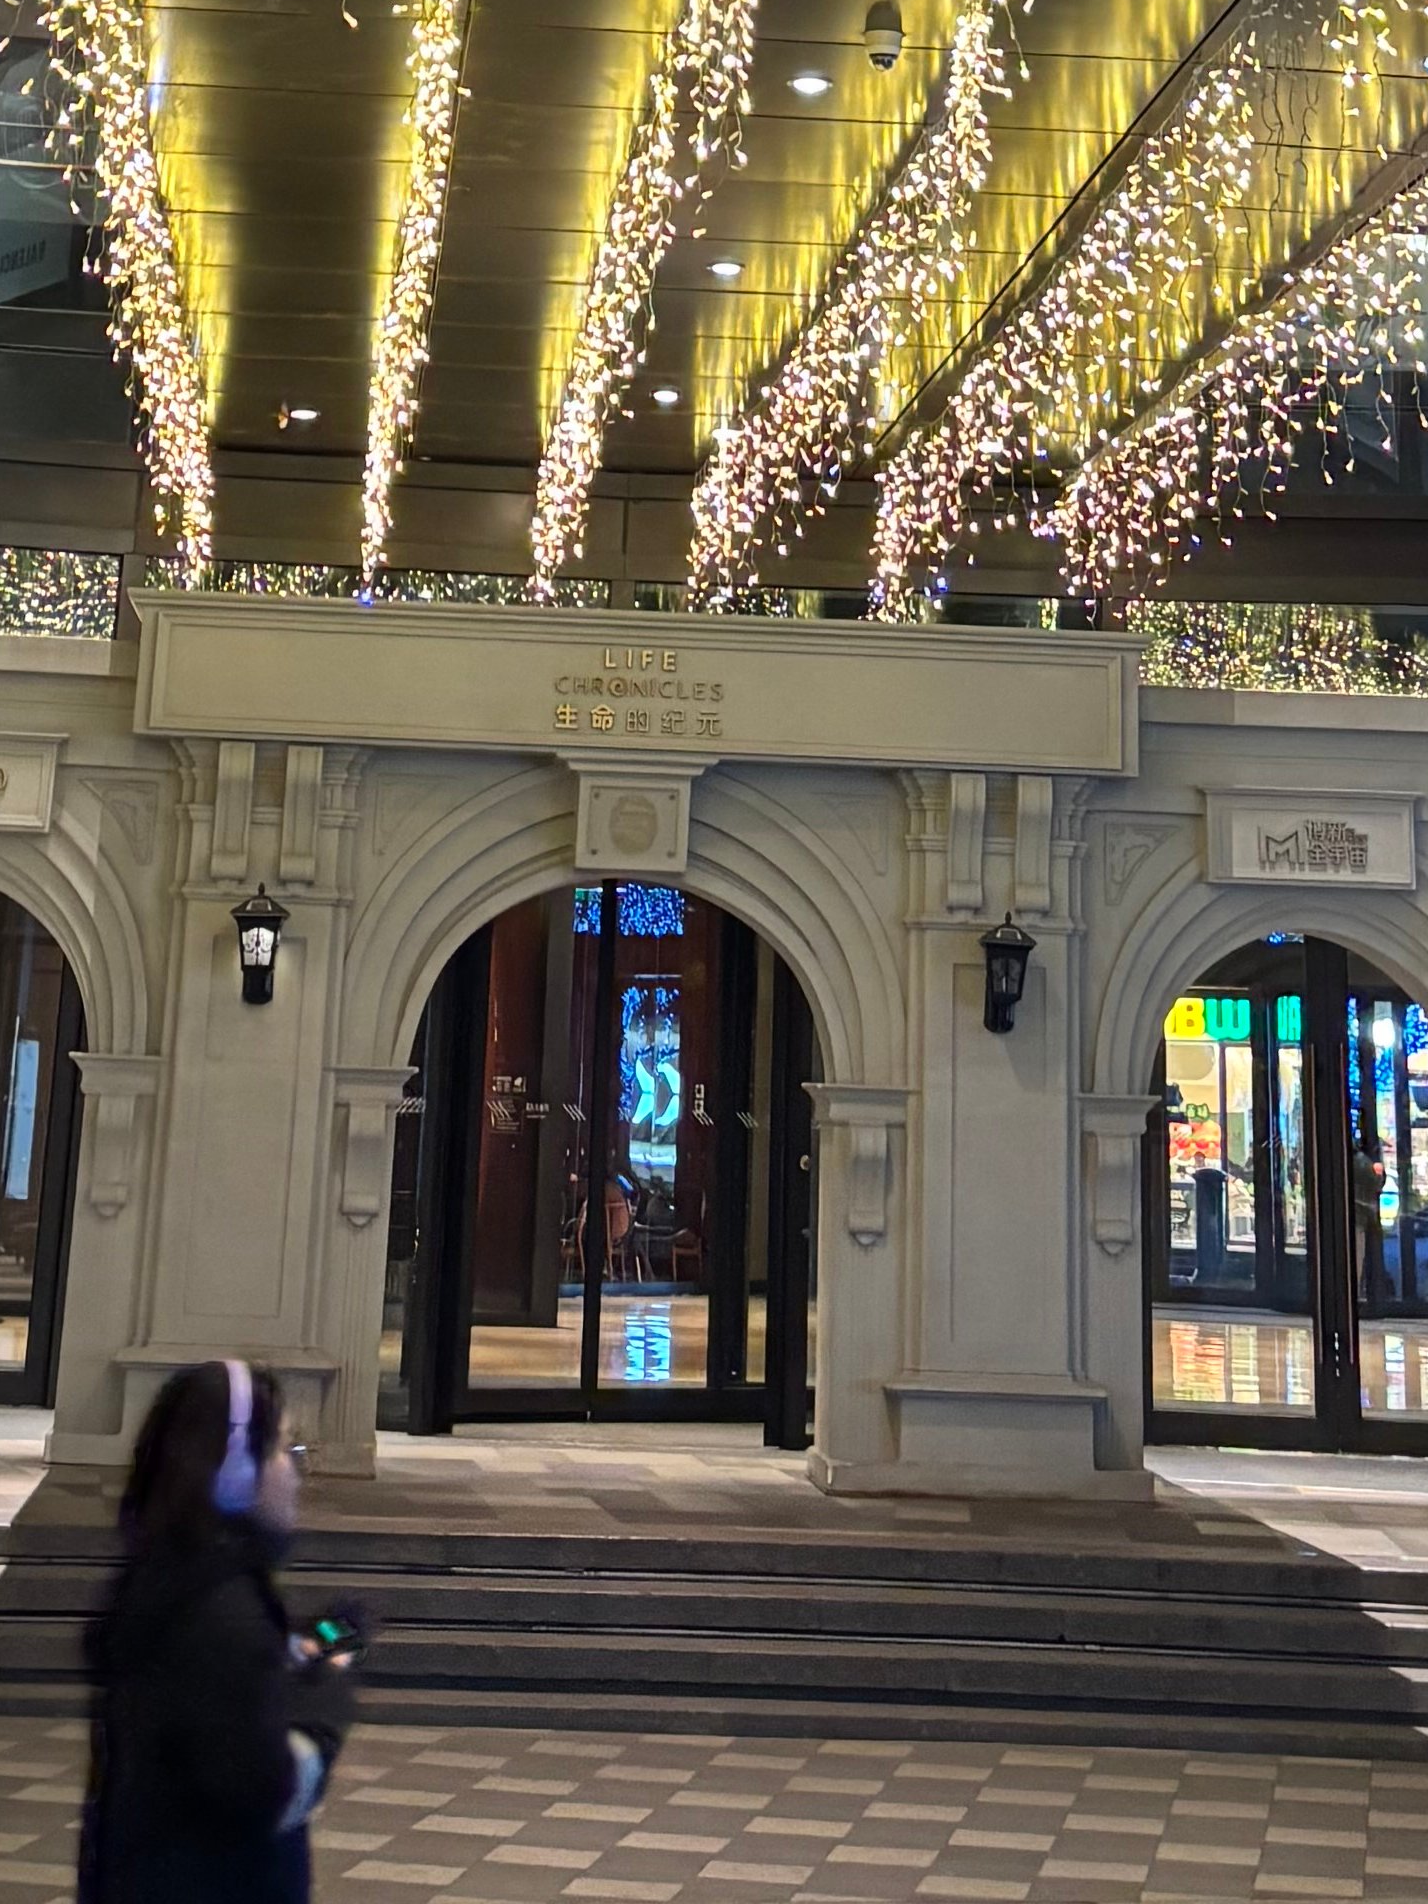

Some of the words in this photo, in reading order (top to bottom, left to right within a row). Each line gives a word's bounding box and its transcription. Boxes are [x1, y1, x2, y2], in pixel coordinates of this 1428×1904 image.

[604, 648, 677, 672] LIFE
[554, 677, 725, 702] CHRONICLES
[555, 703, 722, 737] 生命的纪元
